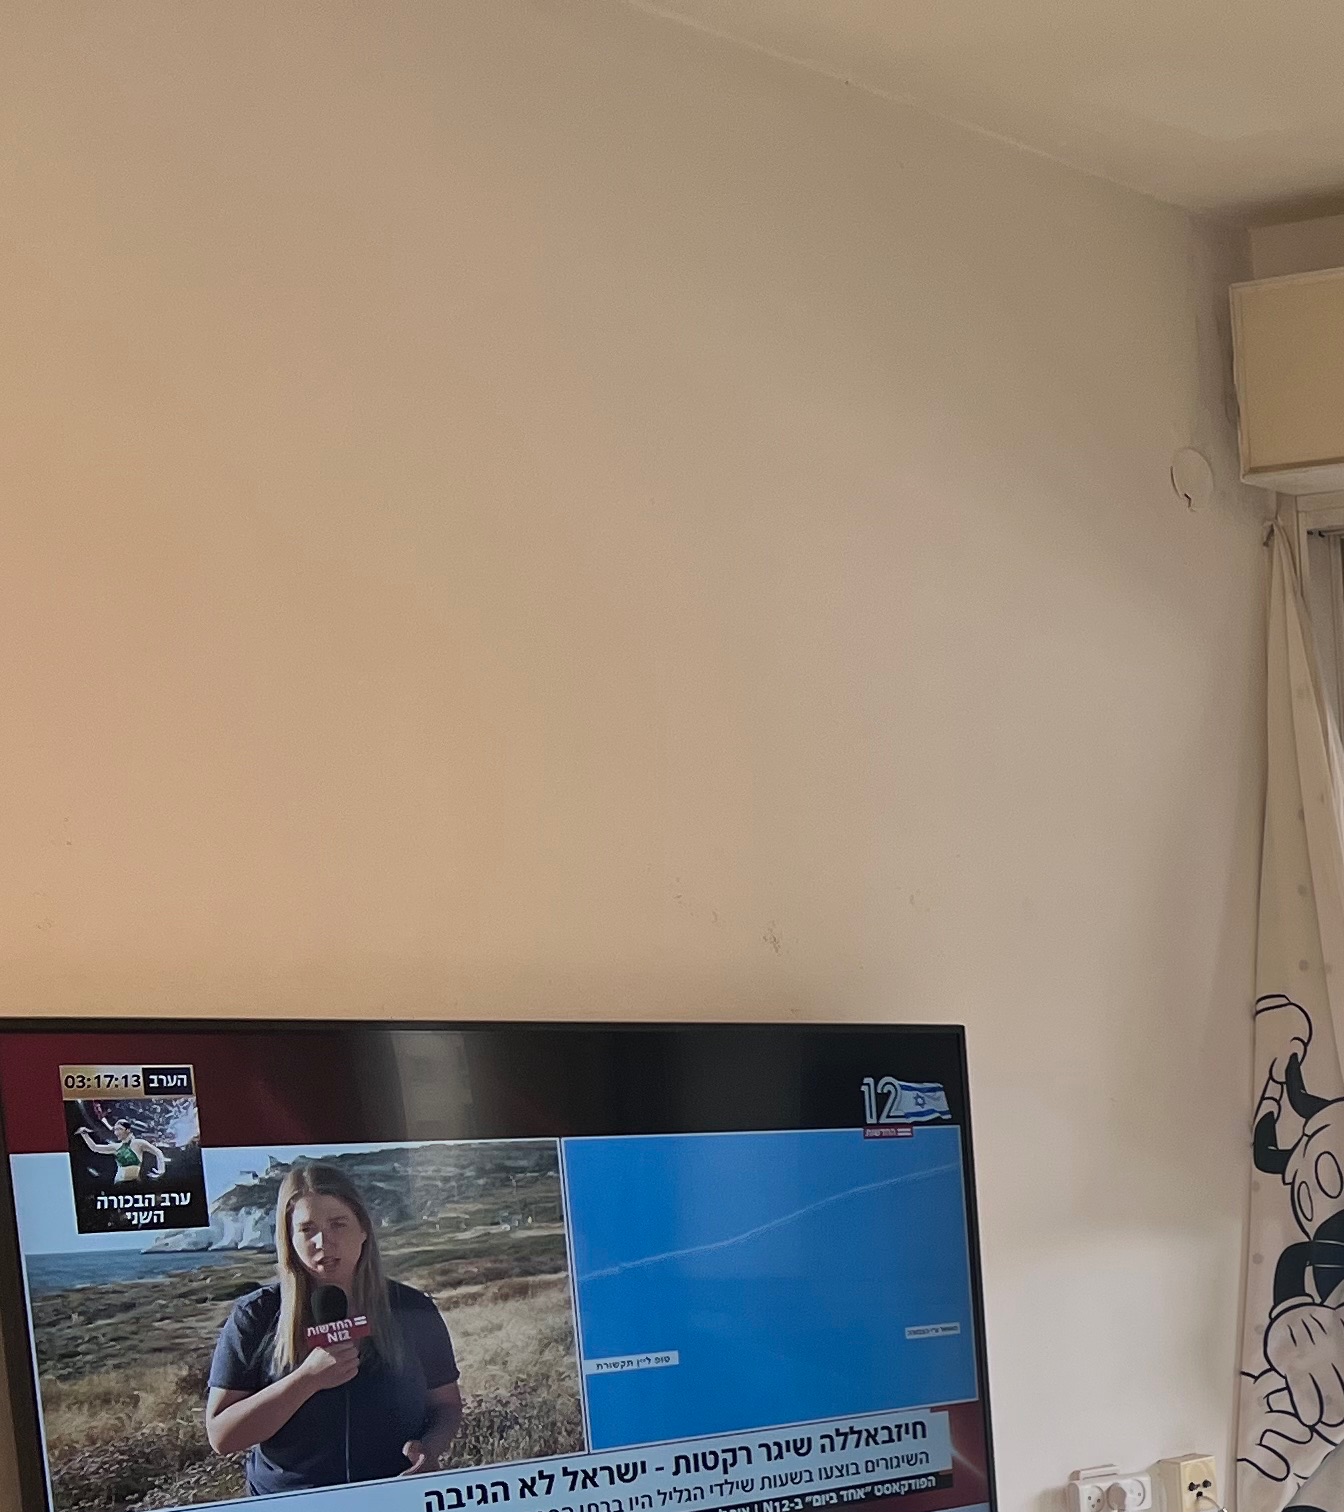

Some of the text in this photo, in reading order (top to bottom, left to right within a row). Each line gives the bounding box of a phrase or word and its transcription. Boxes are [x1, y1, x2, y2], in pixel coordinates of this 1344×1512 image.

[64, 1074, 141, 1089] 03:17:13
[149, 1074, 187, 1088] הערב
[860, 1076, 911, 1124] 12
[96, 1192, 191, 1210] ערב הבכורה
[125, 1210, 165, 1225] השני
[307, 1319, 352, 1337] החדשות
[820, 1420, 927, 1454] חיזבאללה
[672, 1445, 752, 1476] רקטות
[758, 1437, 812, 1462] שיגר
[818, 1461, 860, 1481] בוצעו
[865, 1451, 930, 1474] השיגורים
[518, 1470, 555, 1499] לא
[562, 1460, 647, 1492] ישראל
[760, 1469, 814, 1491] בשעות
[874, 1475, 936, 1497] הפודקאסט
[424, 1480, 511, 1512] הגיבה
[657, 1485, 705, 1506] הגליל
[709, 1478, 755, 1498] שילדי
[629, 1494, 653, 1511] היו
